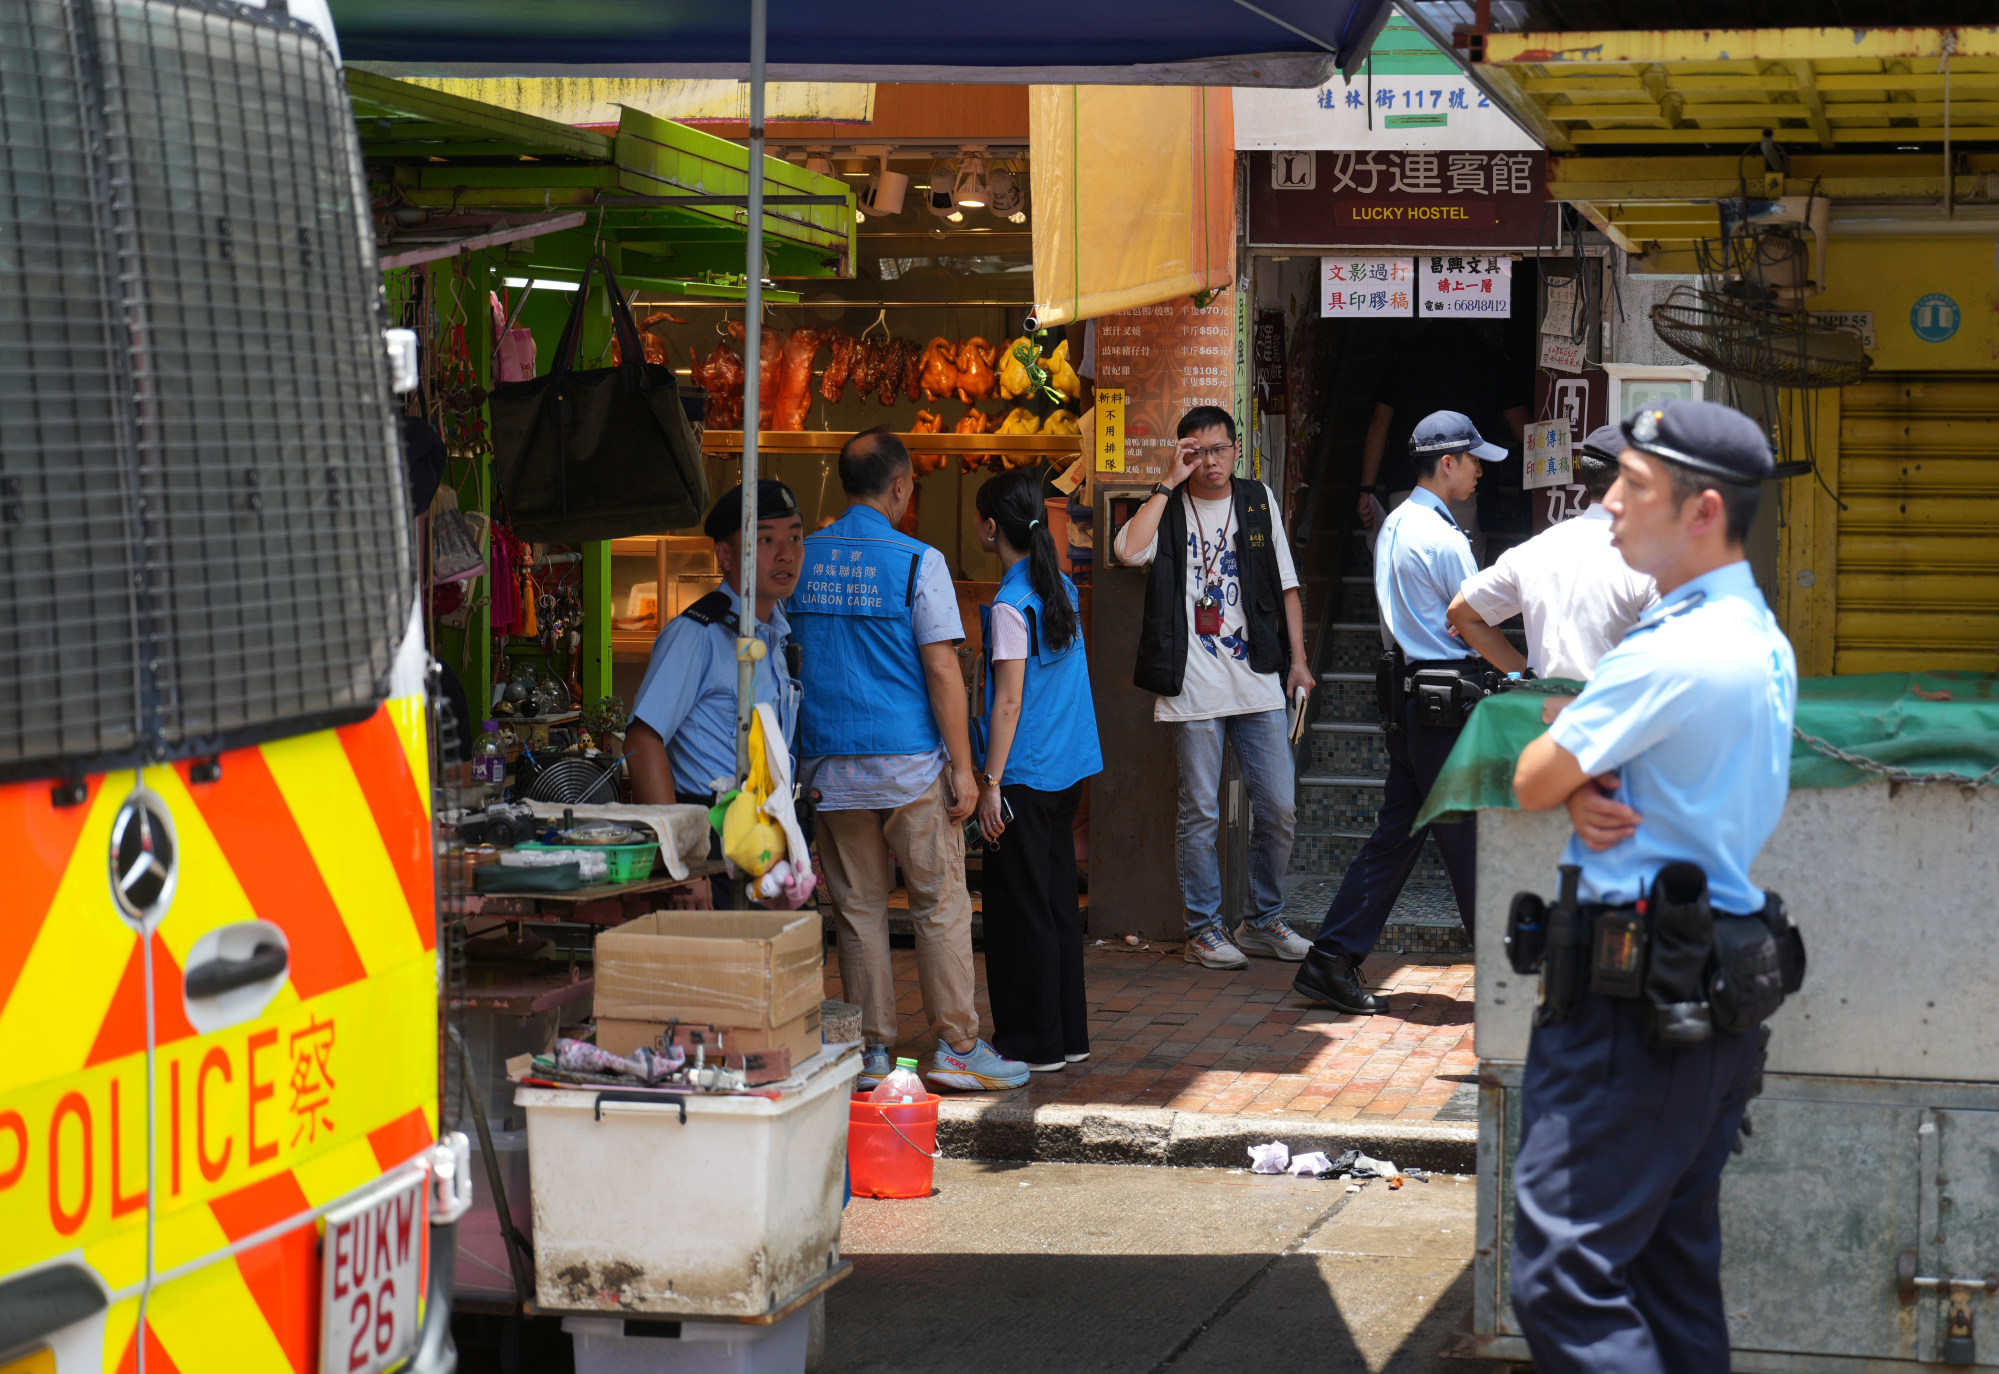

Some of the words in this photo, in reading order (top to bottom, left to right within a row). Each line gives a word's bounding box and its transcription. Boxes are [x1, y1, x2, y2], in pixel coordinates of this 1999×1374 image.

[1332, 150, 1532, 194] 好運賓館
[1352, 207, 1403, 220] LUCKY
[1408, 207, 1469, 220] HOSTEL
[1437, 278, 1493, 294] 請上一層
[1454, 300, 1507, 312] 66848412
[1103, 409, 1117, 471] 不用排隊
[831, 549, 863, 562] 警察
[813, 564, 877, 579] 傳媒聯絡隊
[807, 581, 842, 593] FORCE
[846, 584, 879, 595] MEDIA
[802, 594, 843, 606] LIAISON
[847, 597, 882, 608] CADRE
[944, 1055, 967, 1071] HOKA
[0, 1027, 279, 1237] POLICE
[289, 1013, 335, 1149] 察
[333, 1188, 416, 1302] EUKW
[348, 1278, 396, 1374] 26
